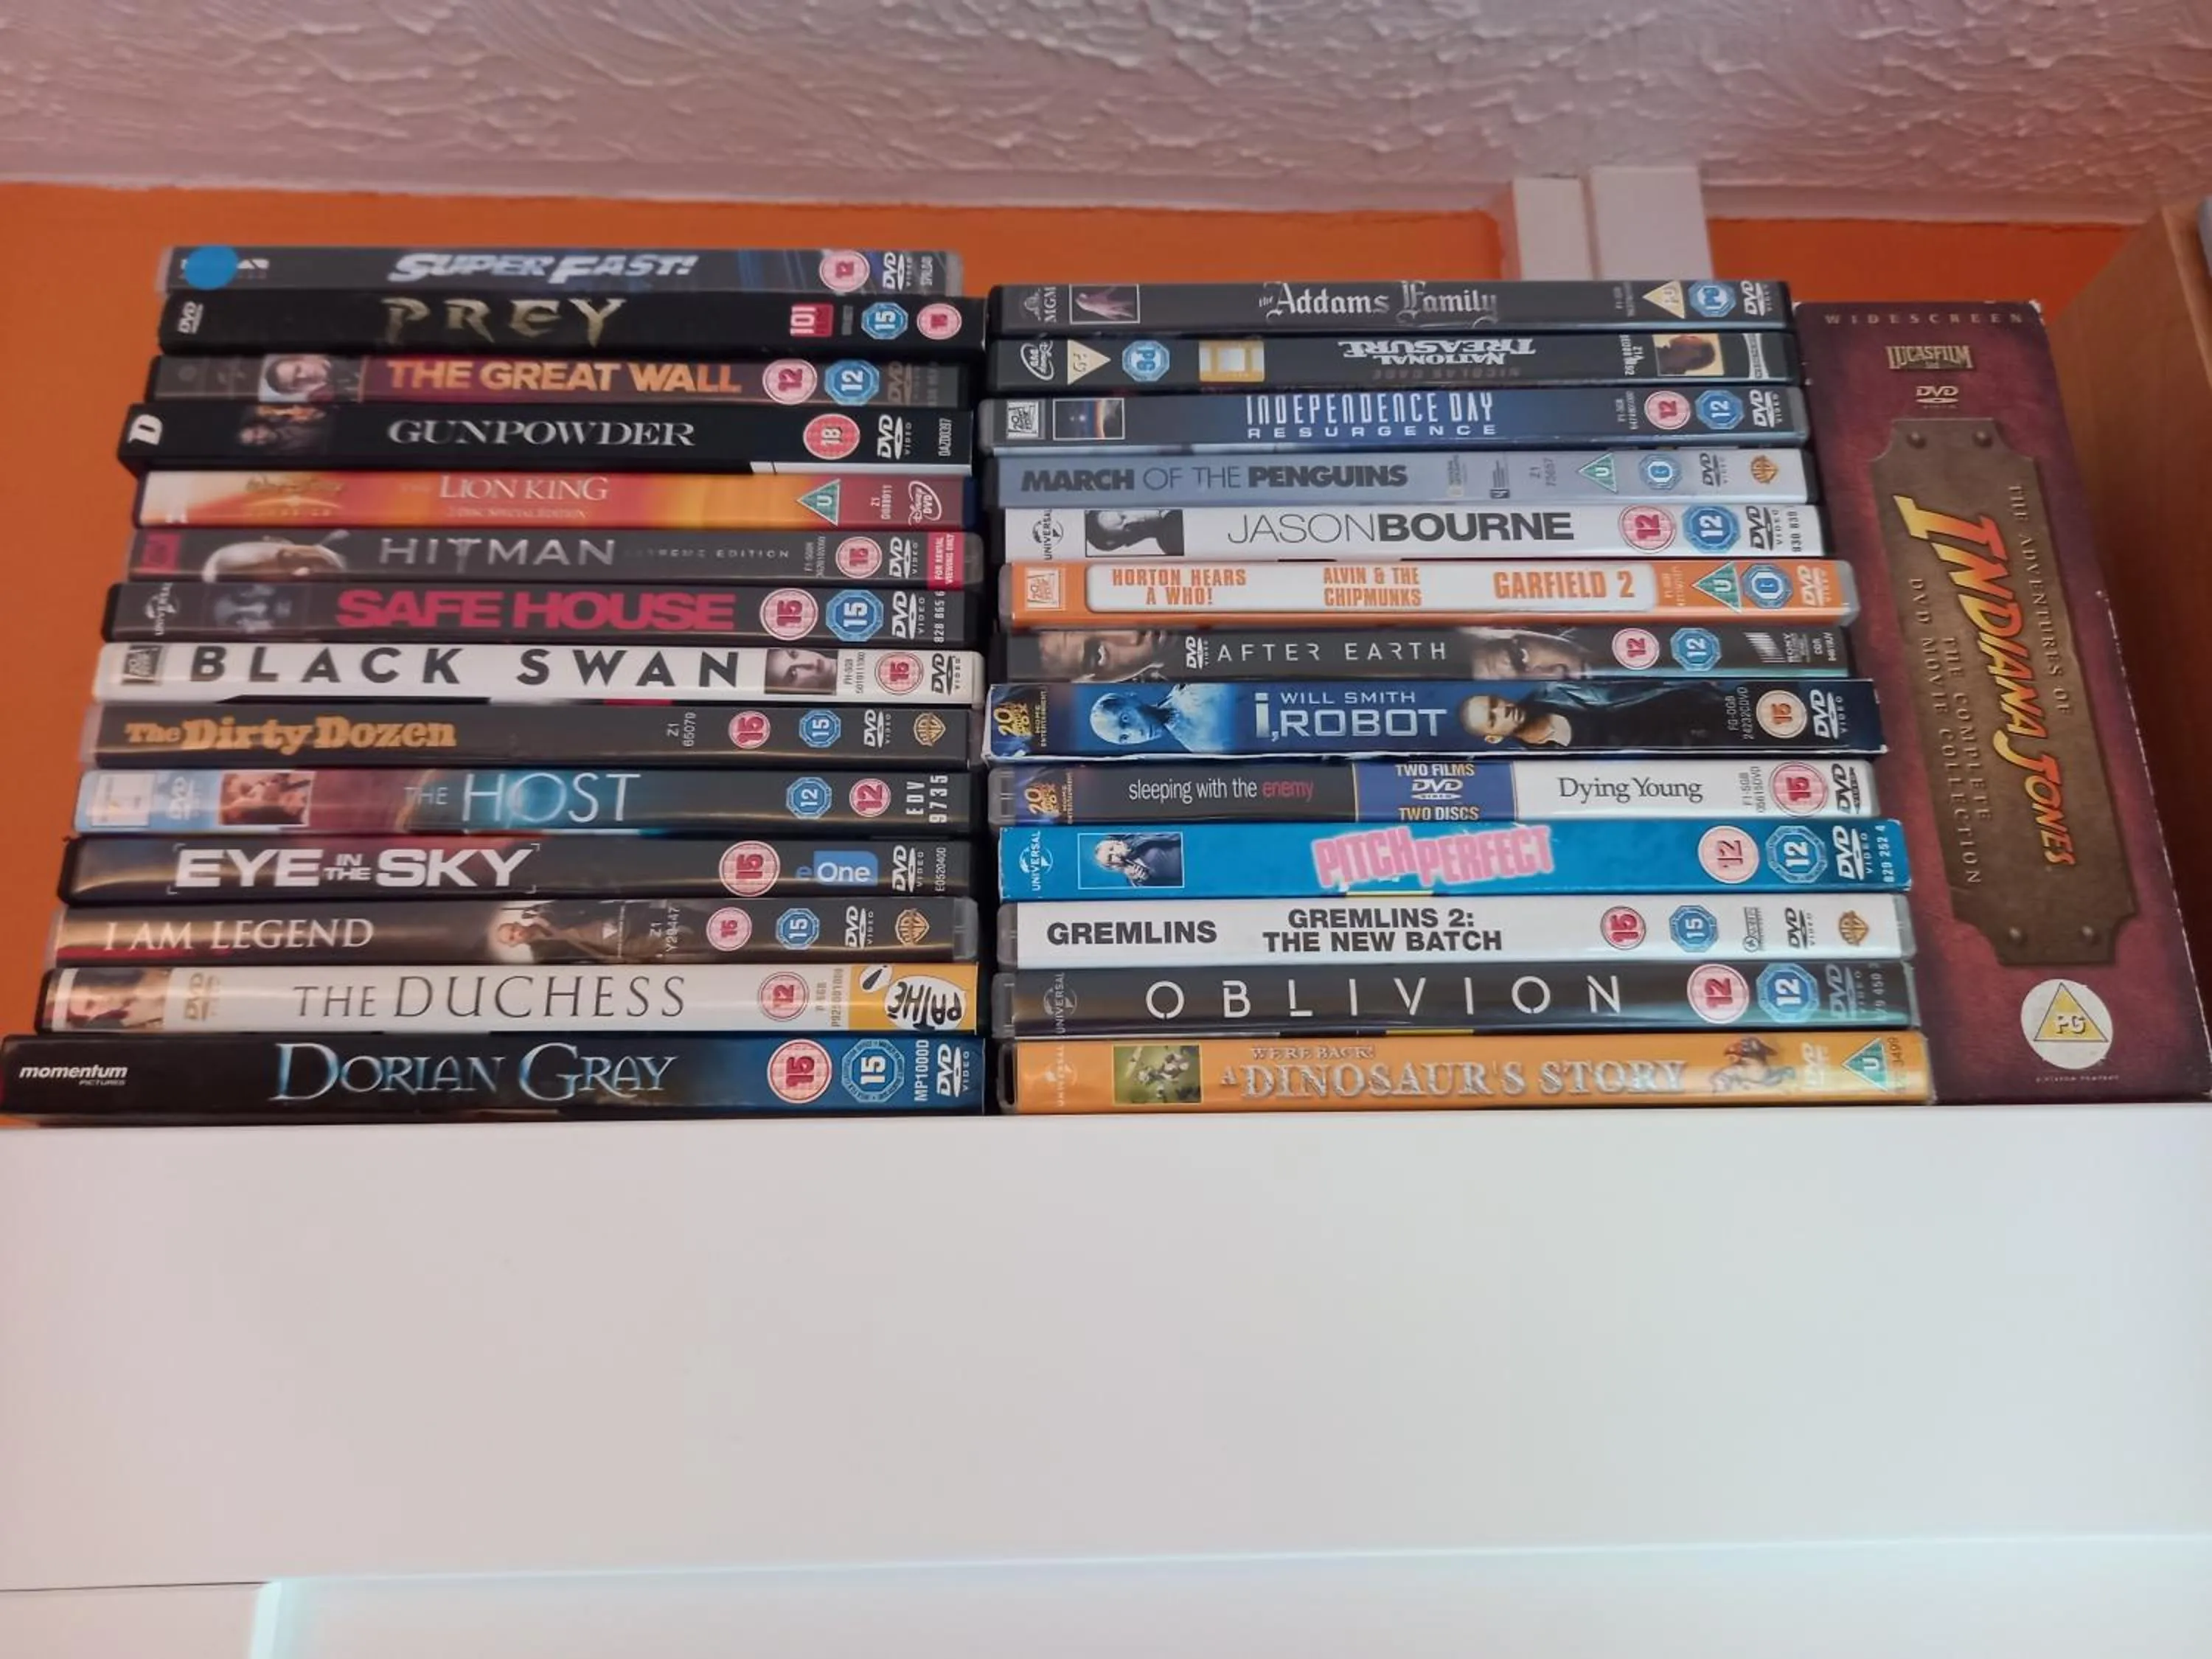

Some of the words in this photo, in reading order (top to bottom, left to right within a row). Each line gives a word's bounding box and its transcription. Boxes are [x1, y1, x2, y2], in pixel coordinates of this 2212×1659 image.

[1044, 286, 1057, 323] MGM
[1264, 282, 1390, 323] Addams
[1396, 282, 1500, 327] Family
[381, 298, 627, 347] PREY
[875, 310, 897, 331] 15
[1825, 313, 2023, 325] WIDESCREEN
[1338, 338, 1537, 358] TREASURE
[1373, 352, 1508, 366] NATIONAL
[1885, 345, 1974, 369] LUCASFILM
[388, 361, 472, 390] THE
[479, 362, 622, 392] GREAT
[628, 363, 742, 394] WALL
[778, 368, 804, 392] 12
[841, 369, 865, 392] 12
[1245, 392, 1439, 425] INDEPENDENCE
[1449, 392, 1493, 422] DAY
[1710, 399, 1732, 419] 12
[388, 417, 695, 448] GUNPOWDER
[1248, 425, 1497, 439] RESURGENCE
[1021, 470, 1135, 493] MARCH
[1143, 466, 1183, 490] OF
[1192, 466, 1242, 489] THE
[1248, 465, 1408, 488] PENGUINS
[1595, 466, 1610, 478] U
[439, 474, 518, 500] LION
[524, 476, 610, 501] KING
[816, 495, 833, 507] U
[1700, 515, 1721, 538] 12
[380, 538, 616, 573] HITMAN
[716, 549, 789, 559] EDITION
[1112, 568, 1180, 587] HORTON
[1191, 567, 1246, 586] HEARS
[1323, 567, 1366, 585] ALVIN
[1374, 567, 1385, 585] &
[1391, 566, 1420, 585] THE
[1493, 571, 1608, 601] GARFIELD
[1616, 569, 1635, 599] 2
[1715, 579, 1733, 594] U
[1146, 587, 1157, 605] A
[1164, 586, 1214, 606] WHO!
[1324, 587, 1423, 607] CHIPMUNKS
[2008, 484, 2028, 521] THE
[2020, 535, 2064, 676] ADVENTURES
[2053, 688, 2073, 714] OF
[335, 589, 503, 629] SAFE
[513, 591, 737, 631] HOUSE
[776, 599, 801, 626] 15
[844, 602, 869, 627] 15
[891, 591, 909, 639] DVD
[1217, 643, 1320, 662] AFTER
[1346, 641, 1445, 661] EARTH
[1687, 636, 1707, 656] 12
[191, 646, 464, 684] BLACK
[517, 649, 740, 689] SWAN
[1893, 494, 2049, 739] INDIANA
[1993, 729, 2076, 866] JONES
[1281, 692, 1335, 705] WILL
[1344, 691, 1416, 704] SMITH
[125, 722, 181, 743] The
[182, 716, 313, 754] Dirty
[314, 716, 456, 748] Dozen
[813, 717, 830, 739] 15
[1908, 577, 1933, 625] DVD
[1921, 638, 1949, 714] MOVIE
[1939, 728, 1983, 884] COLLECTION
[1942, 637, 1963, 678] THE
[1953, 692, 1990, 821] COMPLETE
[1395, 764, 1428, 776] TWO
[1431, 764, 1475, 776] FILMS
[405, 786, 450, 807] THE
[462, 772, 641, 824] HOST
[801, 787, 818, 807] 12
[1128, 779, 1193, 804] sleeping
[1196, 778, 1228, 800] with
[1232, 777, 1257, 798] the
[1262, 782, 1314, 802] enemy
[1411, 778, 1464, 792] DVD
[1557, 776, 1630, 804] Dying
[1635, 775, 1703, 804] Young
[1398, 807, 1431, 821] TWO
[1436, 807, 1480, 821] DISCS
[335, 852, 364, 866] IN
[737, 853, 764, 880] 15
[1032, 831, 1042, 892] UNIVERSAL
[1312, 827, 1412, 889] PITCH
[1410, 825, 1553, 888] PERFECT
[1717, 840, 1745, 869] 12
[1784, 840, 1810, 869] 12
[1832, 826, 1855, 880] DVD
[176, 848, 324, 888] EYE
[324, 867, 372, 882] THE
[376, 848, 534, 888] SKY
[892, 845, 908, 893] DVD
[789, 918, 807, 940] 15
[1288, 908, 1439, 929] GREMLINS
[1447, 909, 1474, 928] 2:
[1686, 918, 1705, 939] 15
[102, 922, 116, 951] I
[129, 920, 189, 950] AM
[210, 918, 375, 950] LEGEND
[1047, 920, 1217, 945] GREMLINS
[1262, 932, 1321, 953] THE
[1331, 931, 1396, 952] NEW
[1405, 931, 1502, 952] BATCH
[293, 985, 377, 1018] THE
[393, 975, 686, 1019] DUCHESS
[773, 984, 795, 1009] 12
[1056, 972, 1065, 1035] UNIVERSAL
[1146, 975, 1621, 1020] OBLIVION
[1776, 978, 1801, 1008] 12
[19, 1065, 128, 1079] momentum
[269, 1042, 507, 1102] DORIAN
[518, 1040, 679, 1102] GRAY
[786, 1055, 815, 1087] 15
[860, 1054, 886, 1083] 15
[936, 1044, 953, 1097] DVD
[1863, 1057, 1881, 1071] U
[1221, 1066, 1238, 1086] A
[1241, 1060, 1528, 1099] DINOSAUR'S
[1538, 1058, 1687, 1096] STORY
